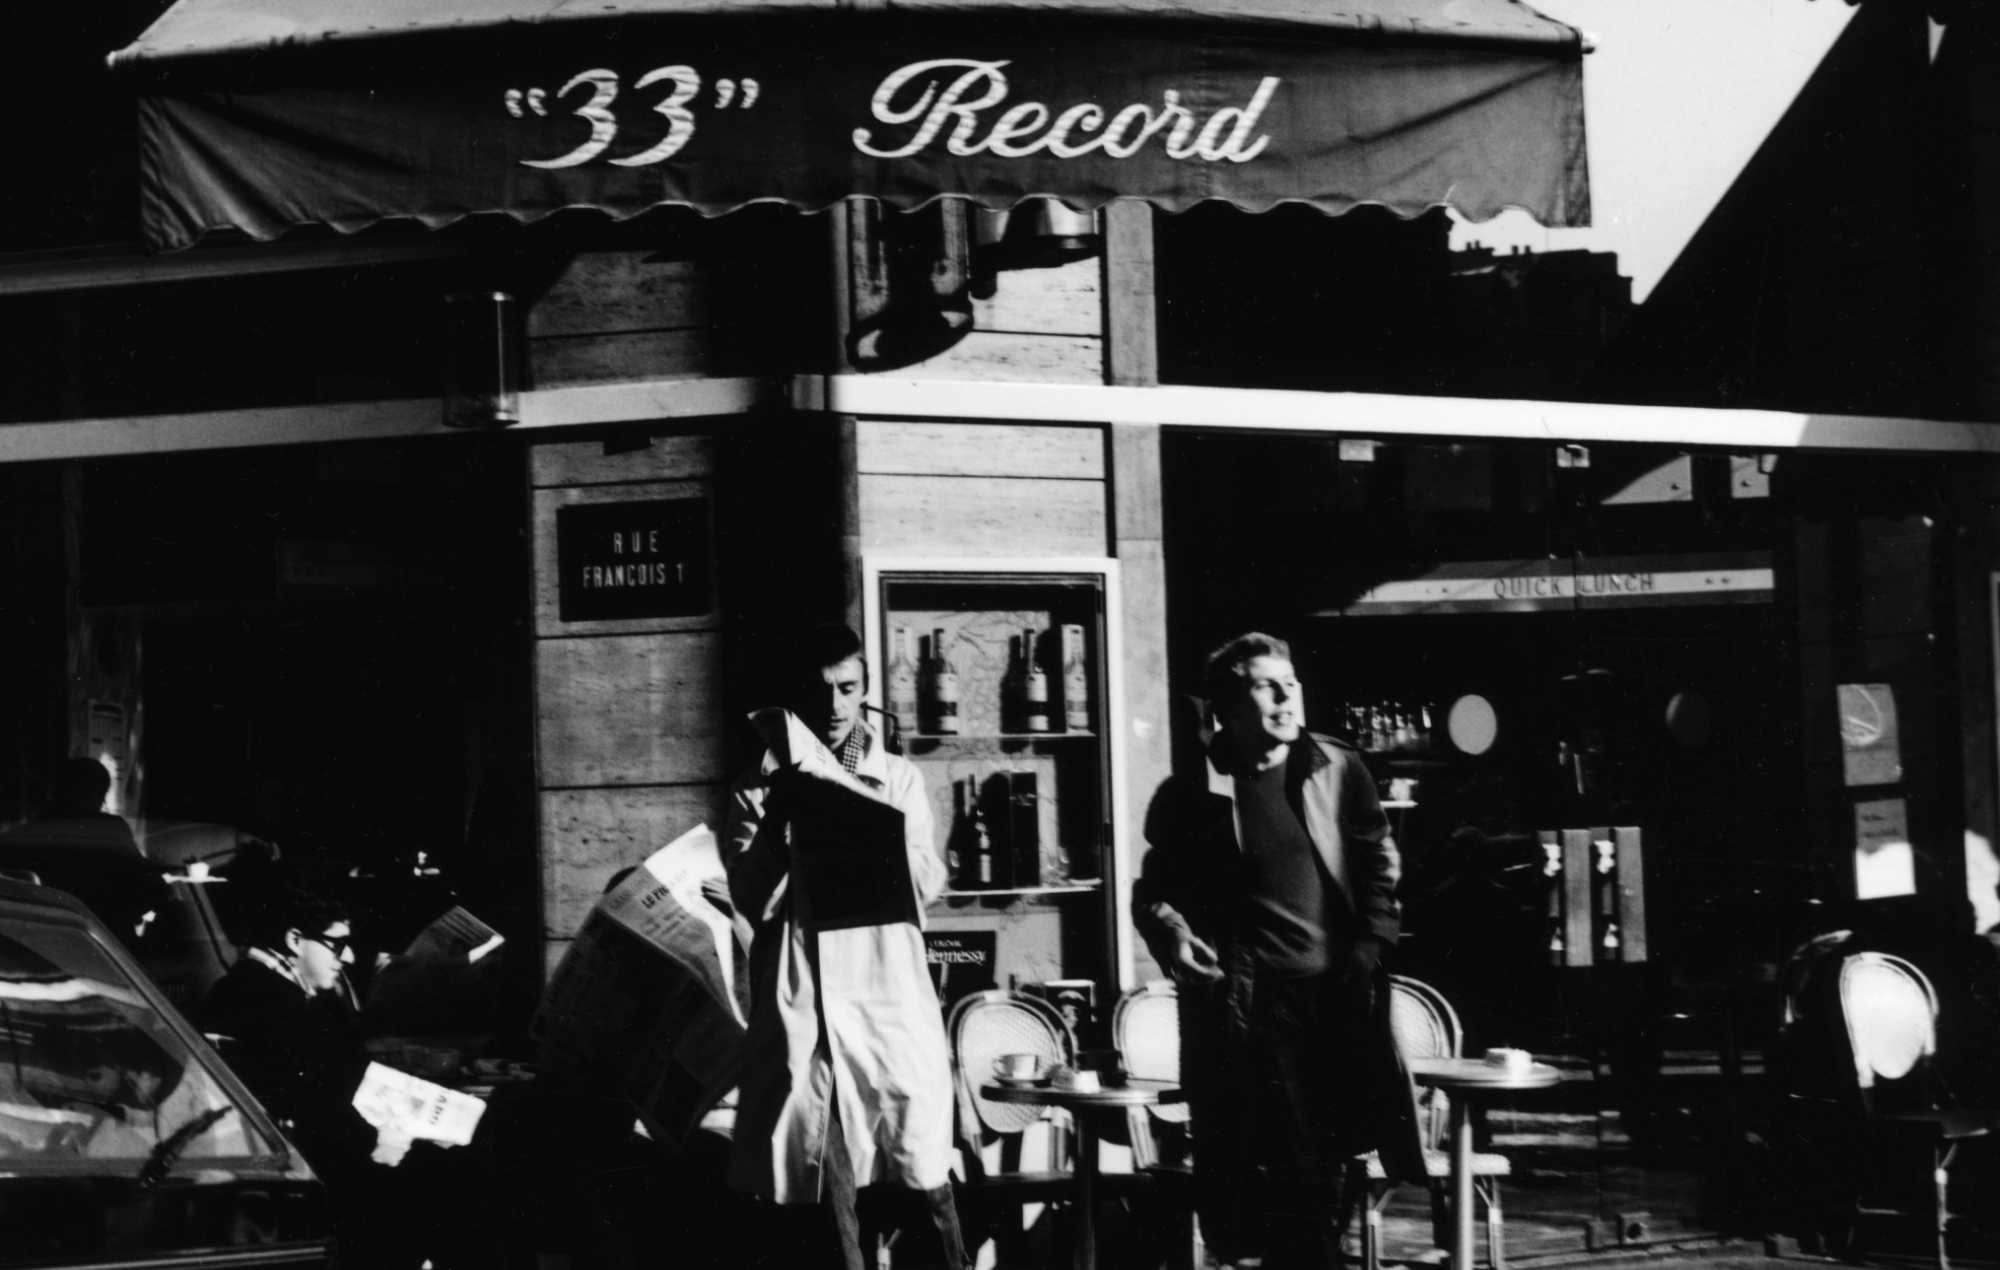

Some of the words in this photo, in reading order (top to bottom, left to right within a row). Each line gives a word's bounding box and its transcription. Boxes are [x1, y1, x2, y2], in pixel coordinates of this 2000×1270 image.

[852, 58, 1282, 163] Record
[613, 530, 659, 554] RUE
[1493, 576, 1563, 599] QUICK
[1578, 572, 1654, 594] LUNCH
